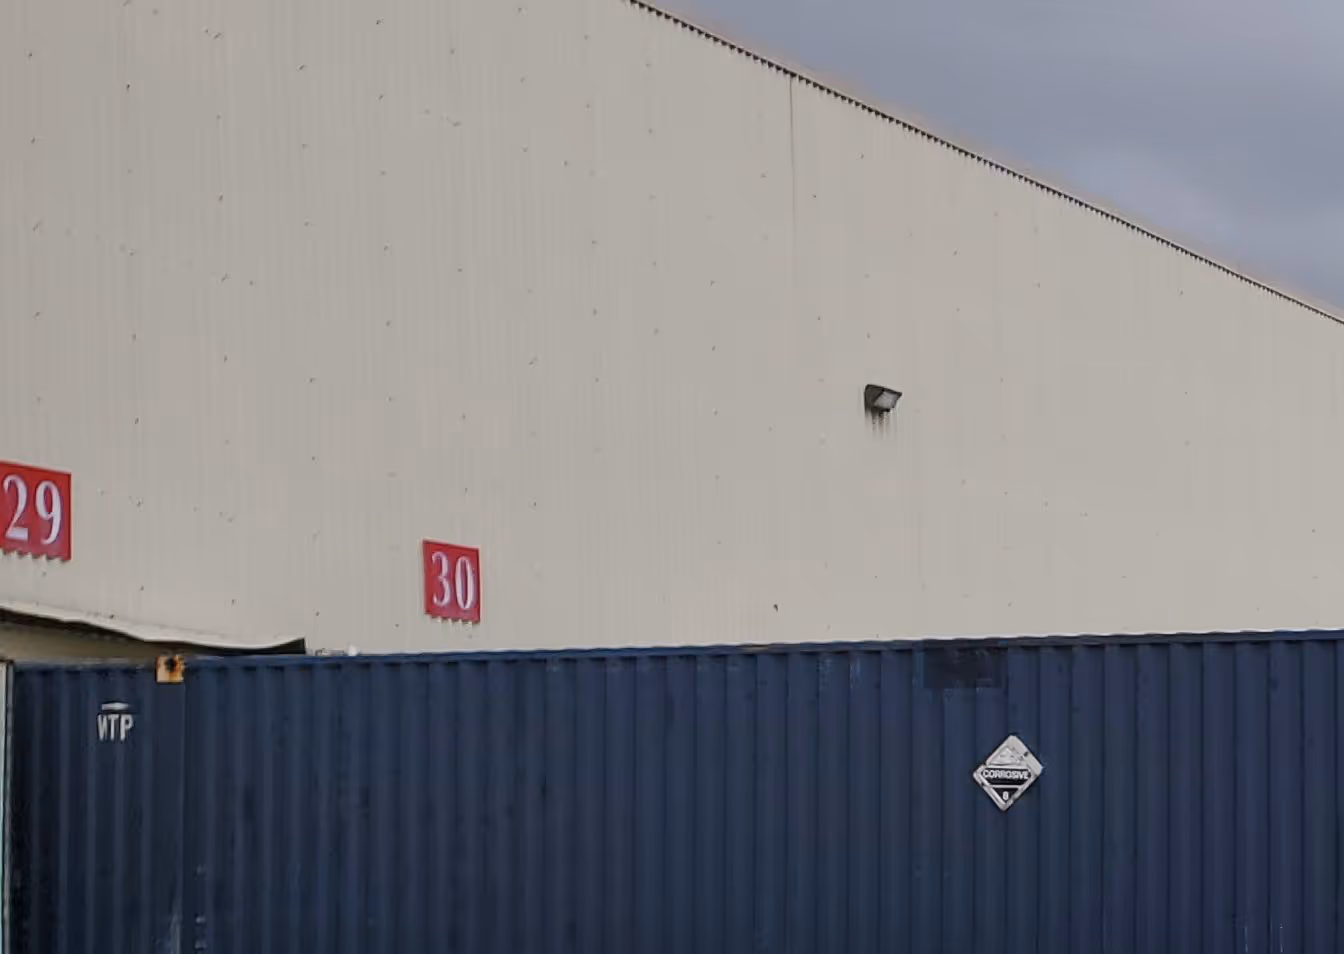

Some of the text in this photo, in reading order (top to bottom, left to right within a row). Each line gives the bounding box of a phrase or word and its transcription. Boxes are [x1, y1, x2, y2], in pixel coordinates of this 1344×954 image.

[3, 473, 62, 545] 29
[431, 552, 477, 612] 30
[96, 713, 134, 741] WTP
[982, 769, 1030, 780] CORROSIVE
[1002, 791, 1009, 800] 8
